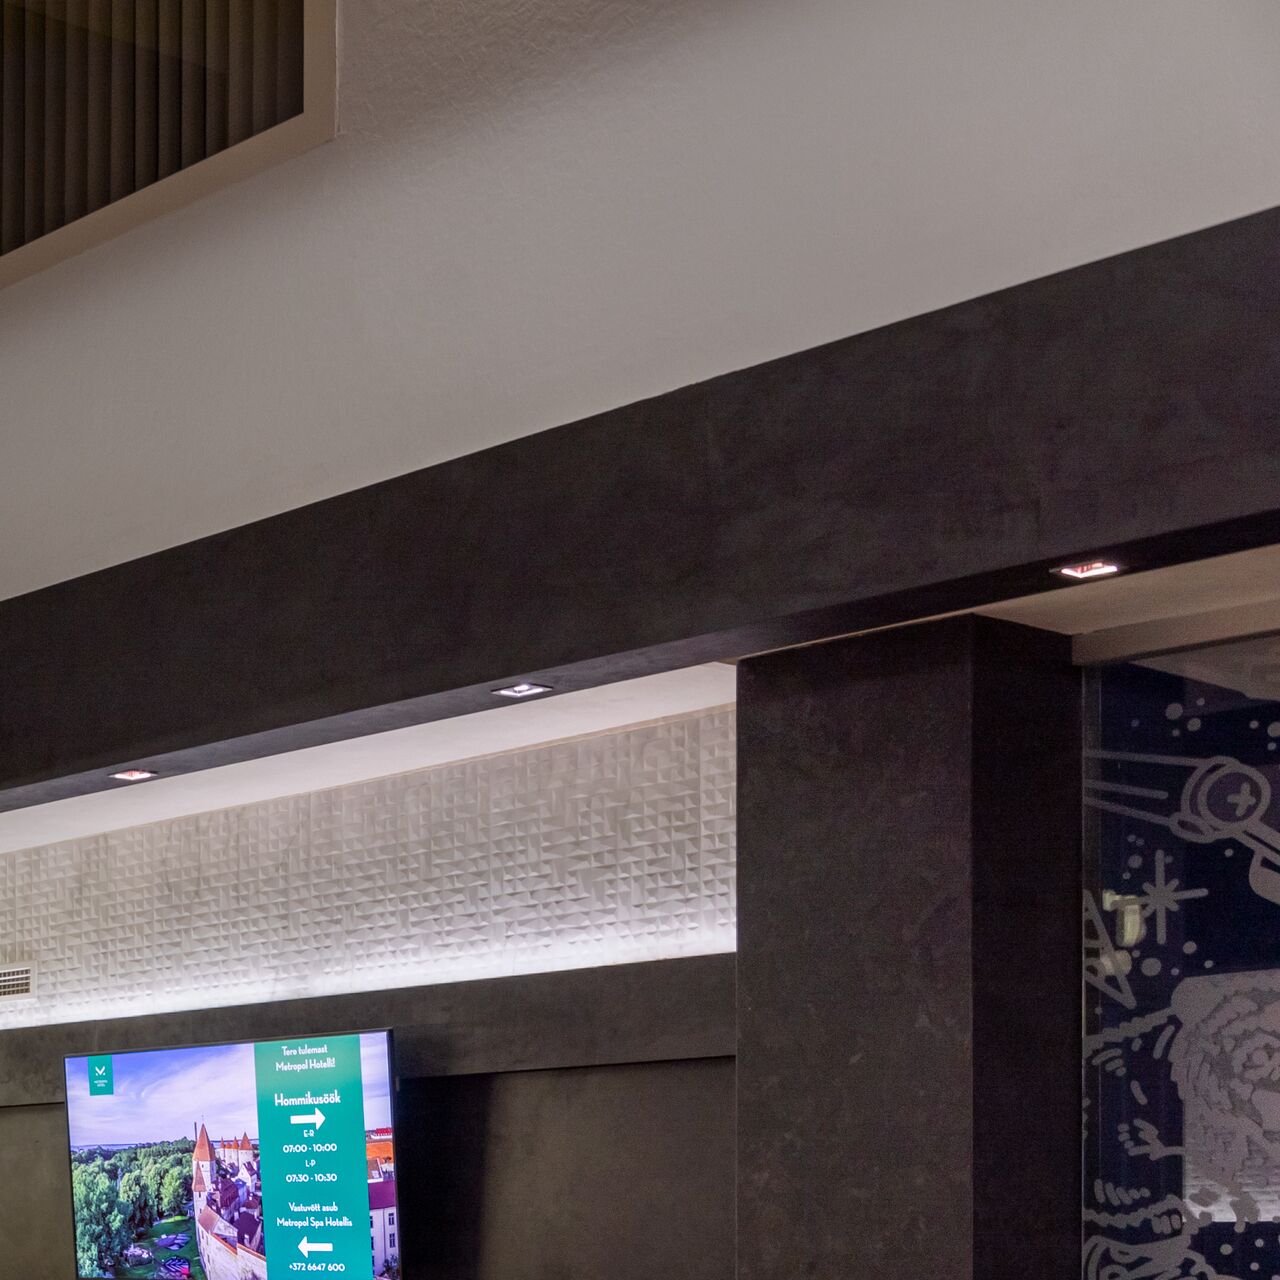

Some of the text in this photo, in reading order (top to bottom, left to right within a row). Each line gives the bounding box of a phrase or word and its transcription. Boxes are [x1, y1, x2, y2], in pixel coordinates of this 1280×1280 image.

[298, 1043, 328, 1055] tulemast
[275, 1058, 308, 1073] Metropol
[274, 1089, 341, 1107] Hommikusöök
[282, 1144, 308, 1153] 07:00
[312, 1143, 337, 1152] 10:00
[285, 1174, 309, 1183] 07:30
[314, 1173, 338, 1182] 10:30
[321, 1201, 338, 1212] asub
[276, 1216, 309, 1229] Metropol
[309, 1216, 324, 1230] Spa
[307, 1262, 326, 1271] 6647
[327, 1263, 346, 1272] 600
